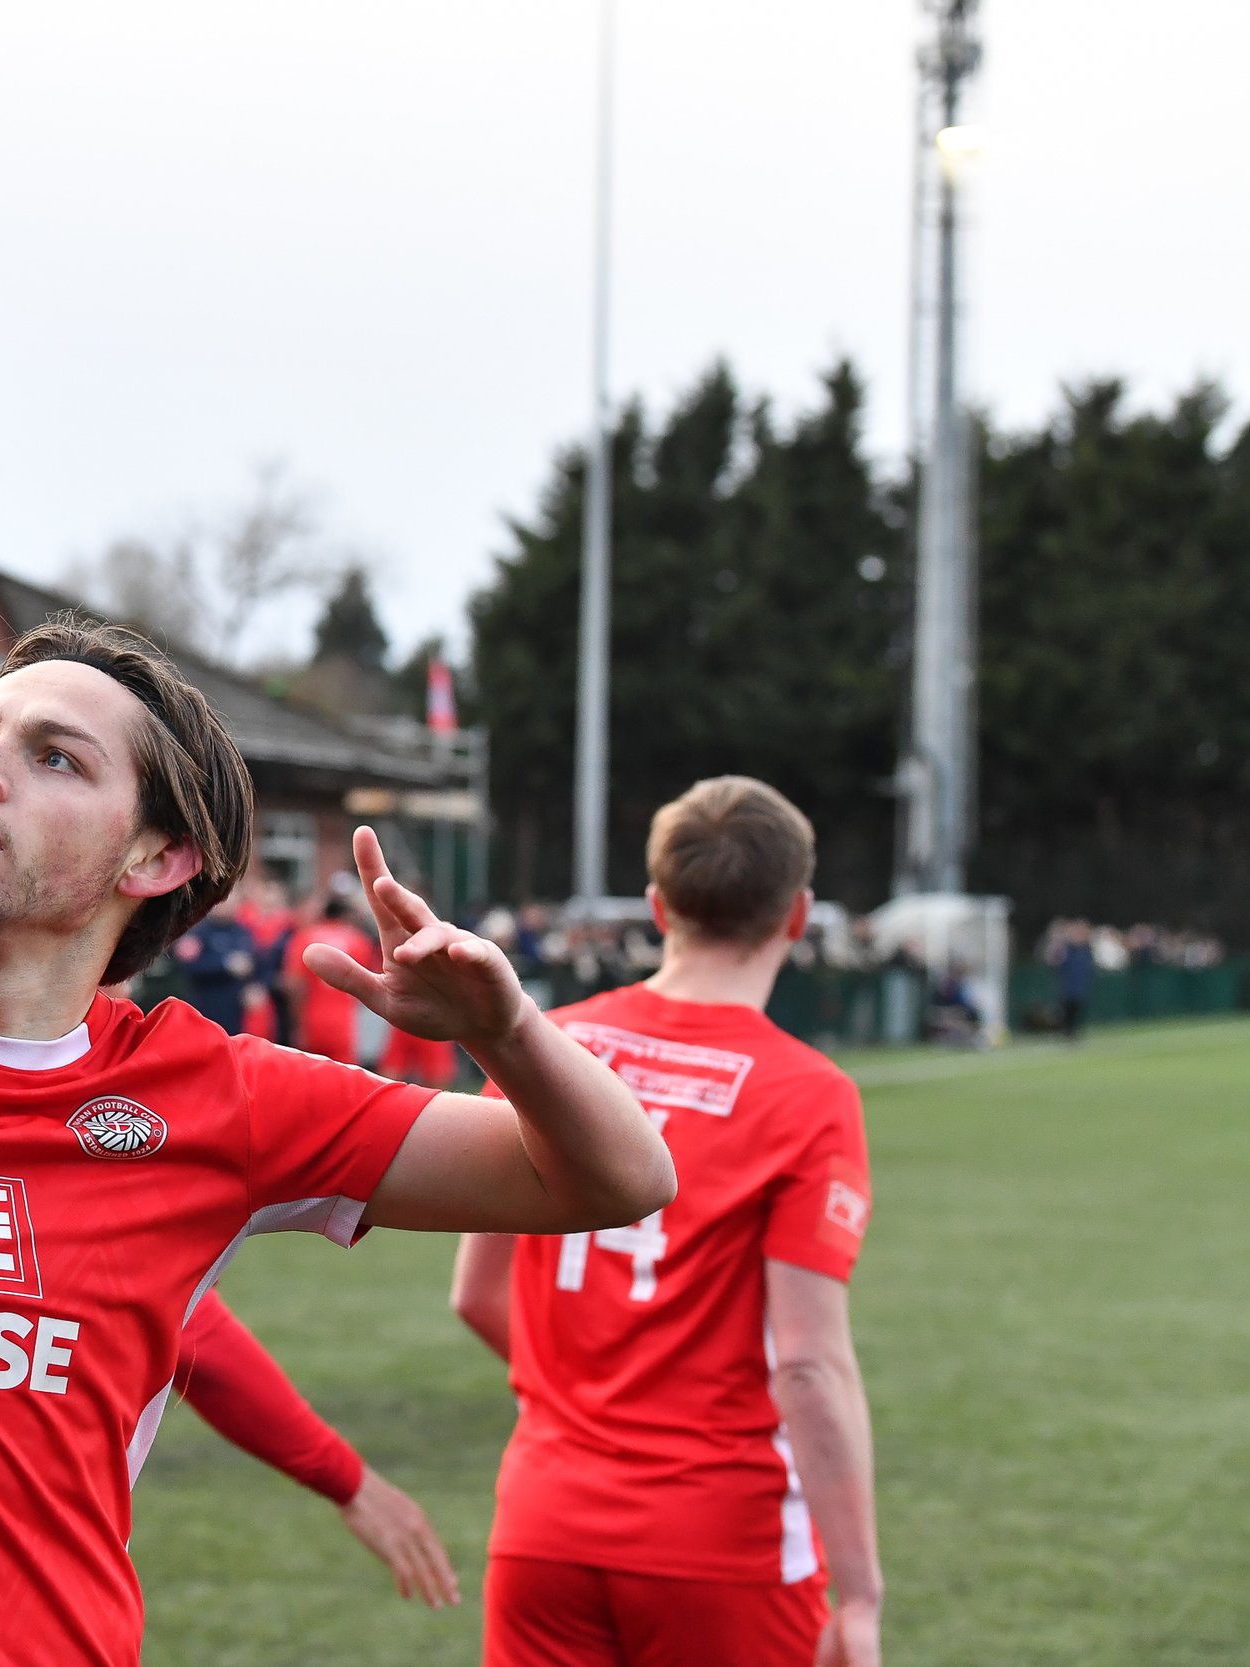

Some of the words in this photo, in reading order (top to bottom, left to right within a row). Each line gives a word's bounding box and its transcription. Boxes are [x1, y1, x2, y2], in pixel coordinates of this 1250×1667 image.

[92, 1102, 138, 1114] FOOTBALL
[83, 1132, 128, 1158] ESTABLISHED
[132, 1144, 151, 1156] 1924
